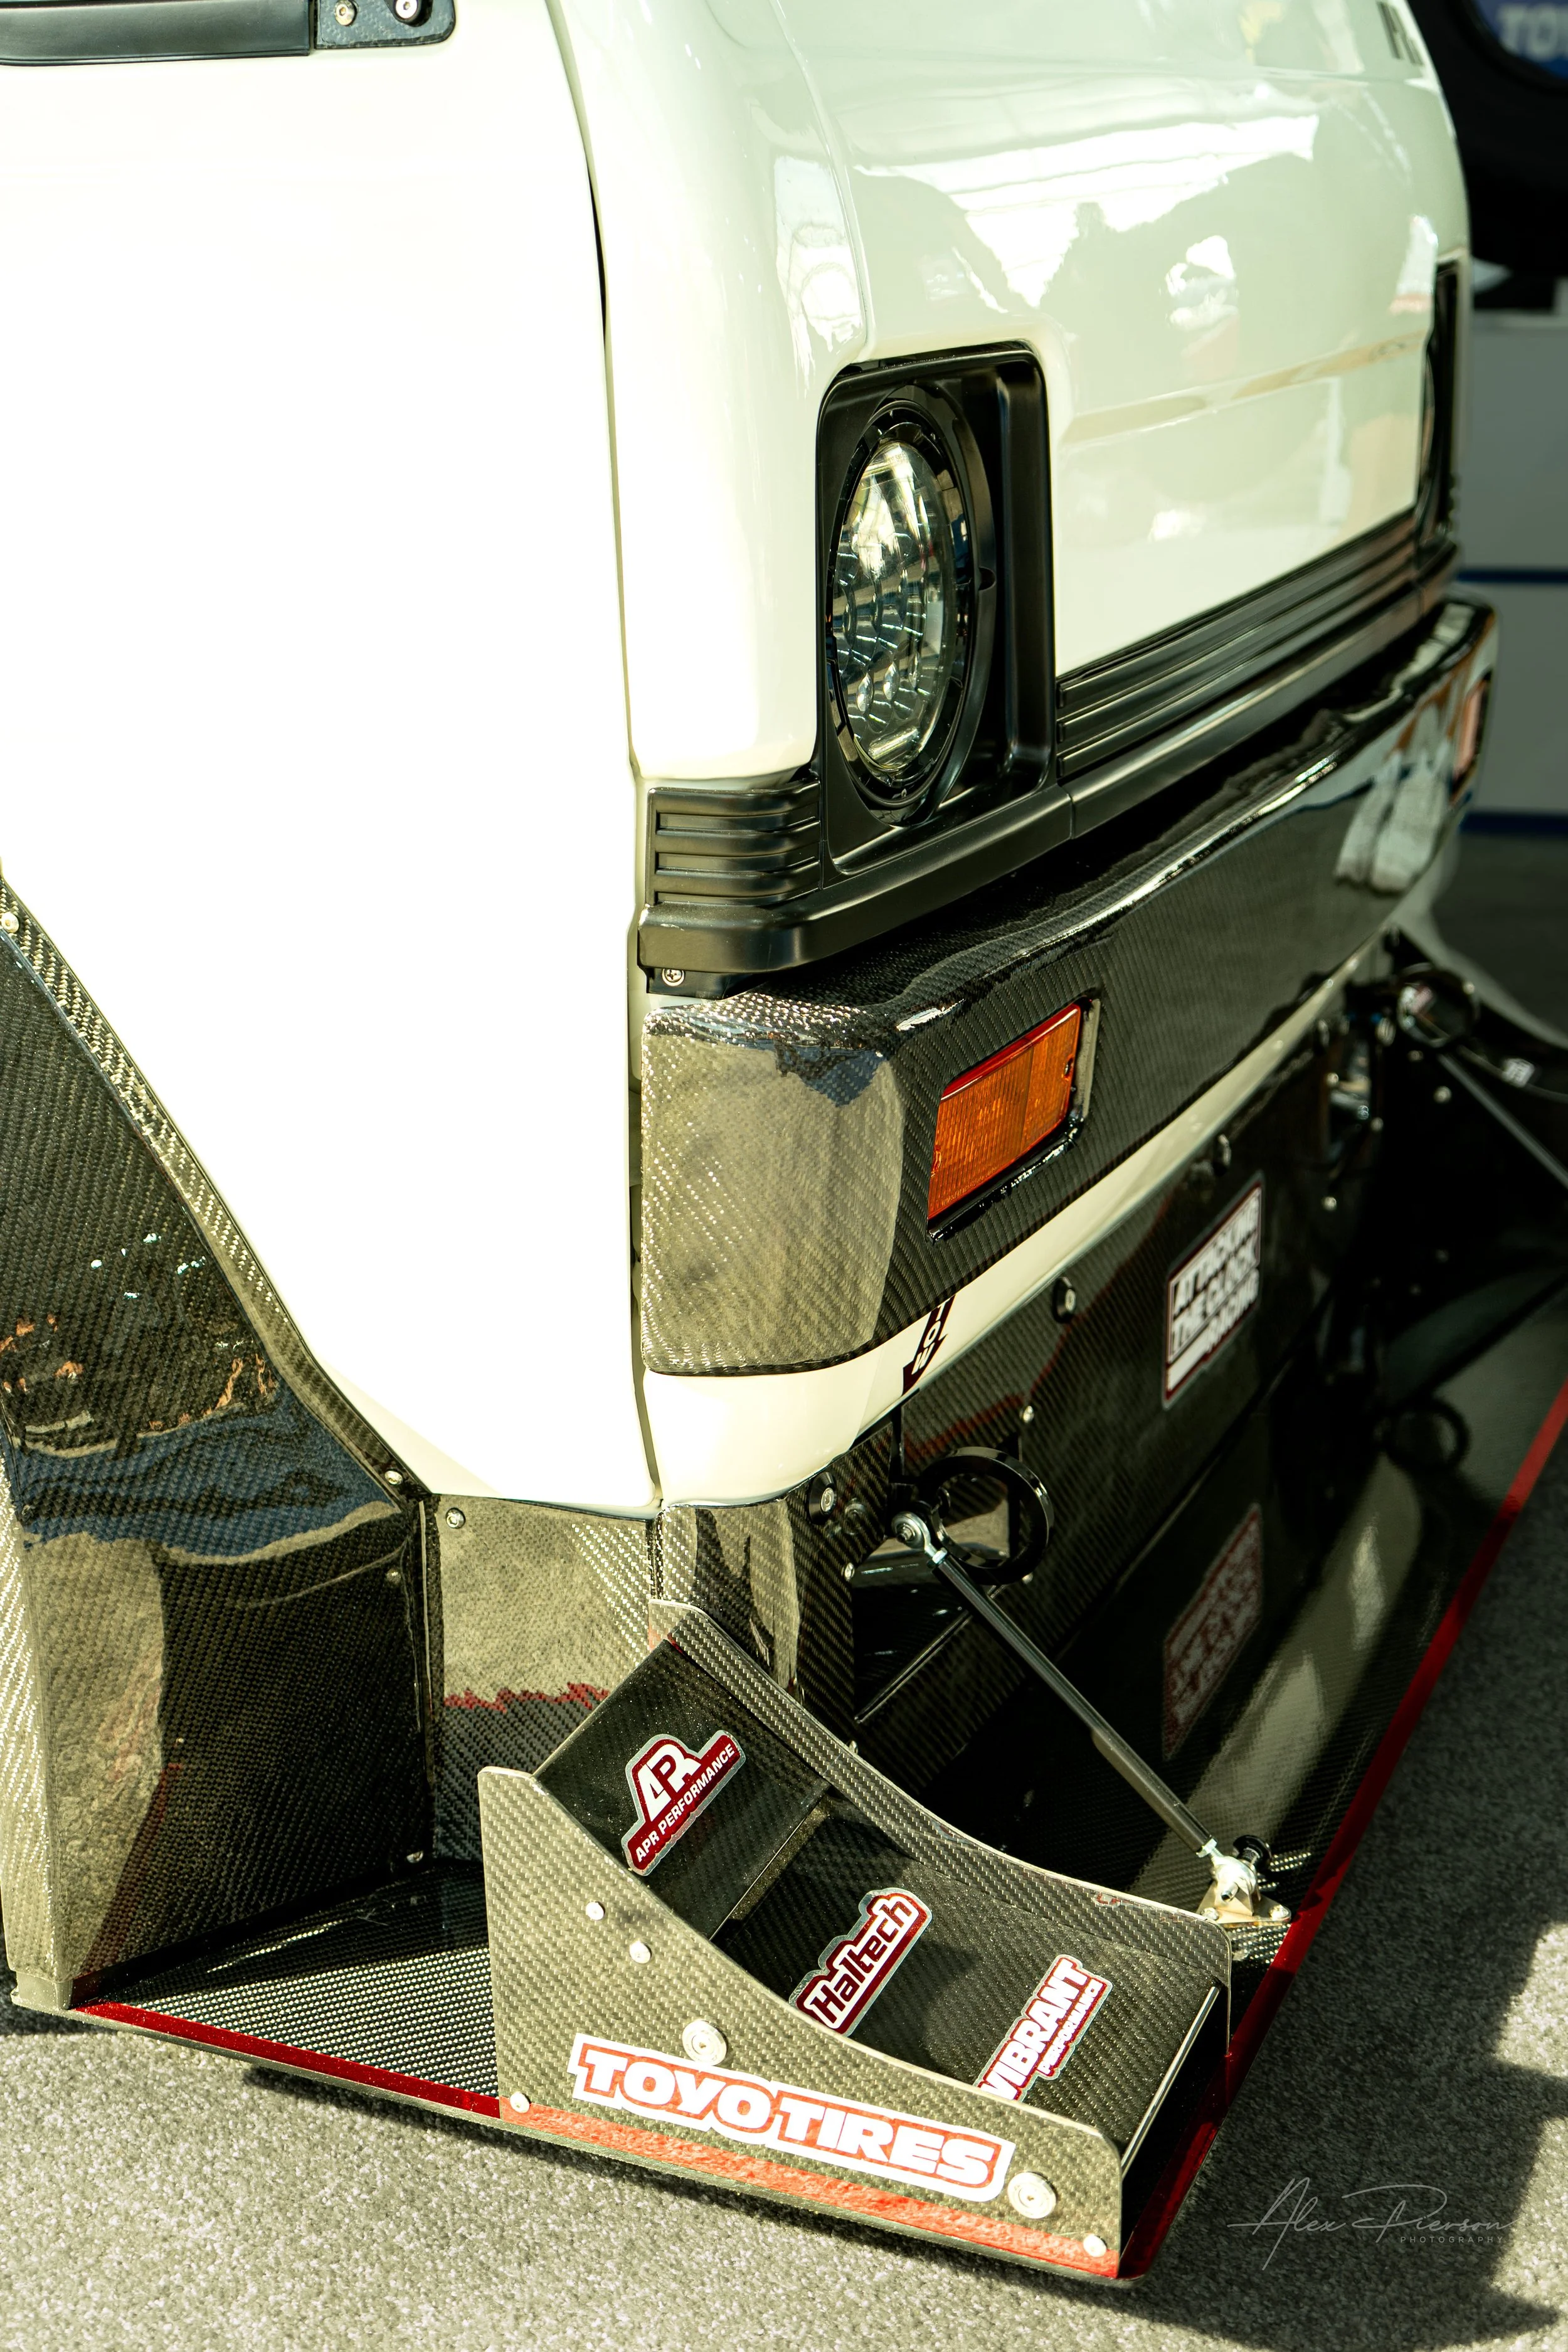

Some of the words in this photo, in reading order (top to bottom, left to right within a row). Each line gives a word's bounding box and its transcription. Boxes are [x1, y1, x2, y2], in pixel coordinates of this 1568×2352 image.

[635, 1830, 660, 1863] APR
[658, 1743, 735, 1835] PERFORMANCE
[810, 1901, 912, 2024] Haltech
[980, 1957, 1088, 2100] VIBRANT
